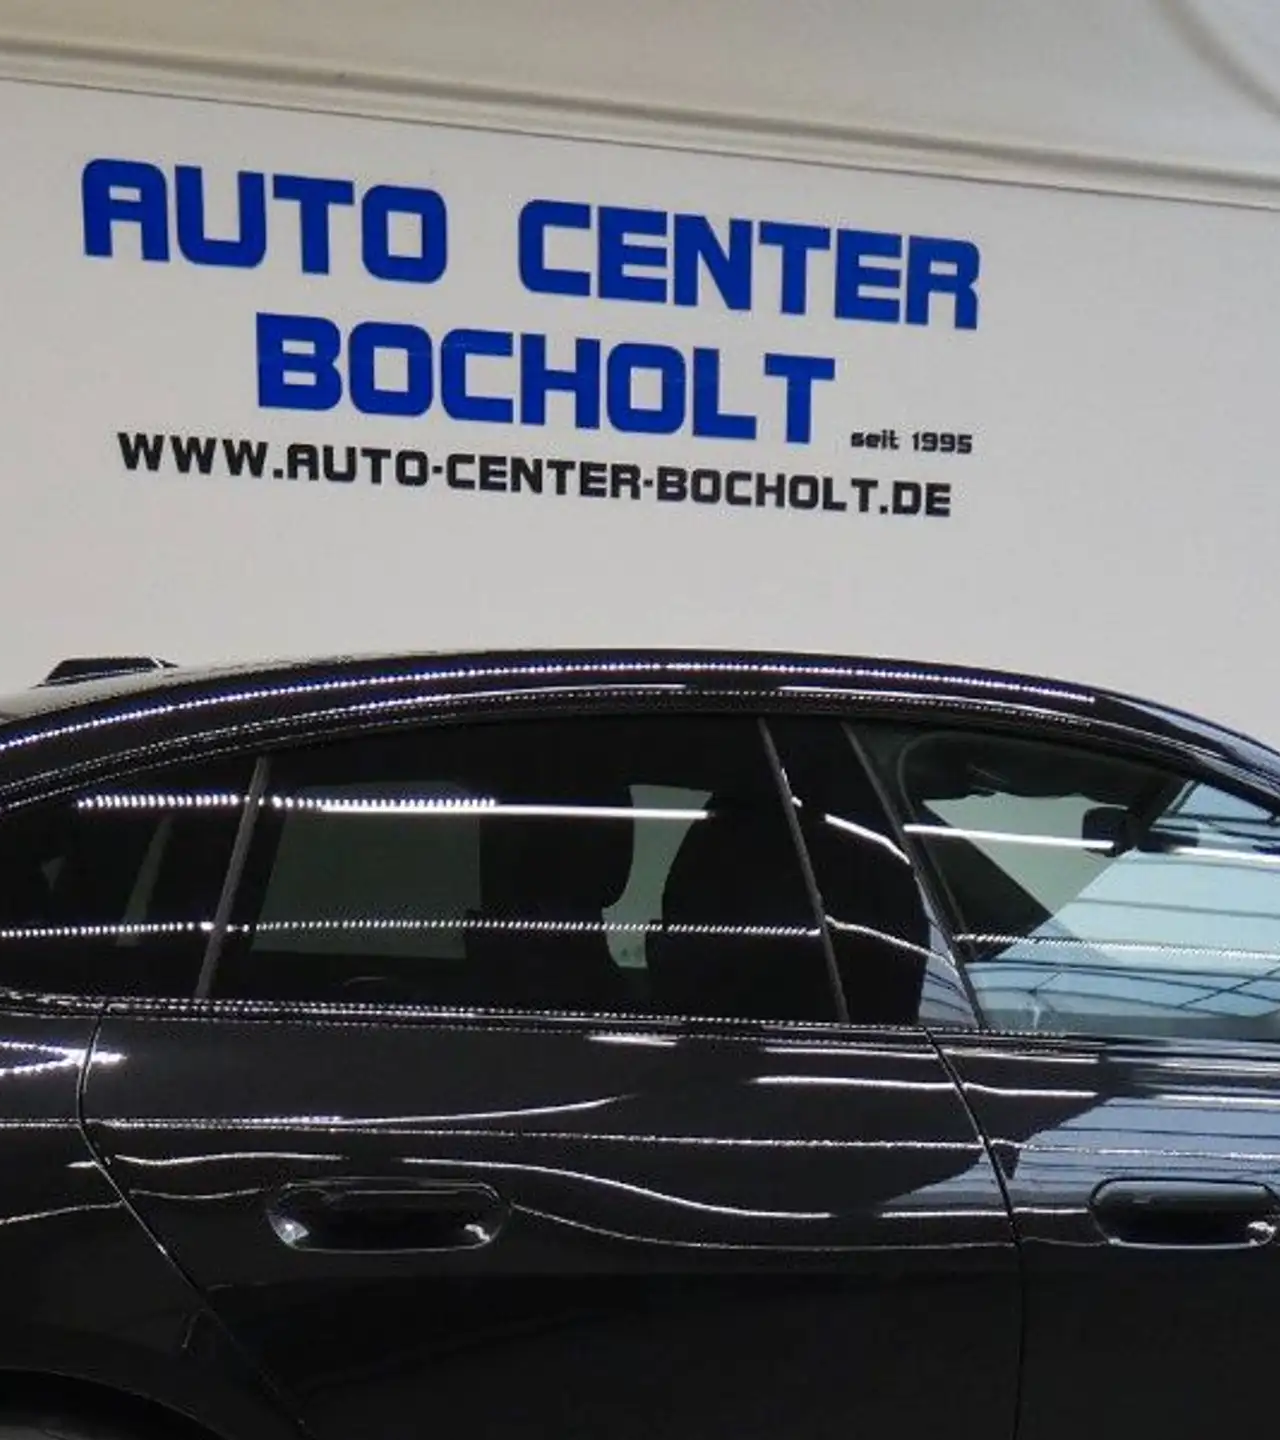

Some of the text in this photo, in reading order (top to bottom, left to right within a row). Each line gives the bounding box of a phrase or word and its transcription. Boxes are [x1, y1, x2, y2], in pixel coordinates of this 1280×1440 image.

[82, 158, 982, 330] AUTO CENTER
[255, 312, 837, 446] BOCHOLT
[117, 432, 952, 517] WWW.AUTO-CENTER-BOCHOLT.DE
[850, 429, 973, 454] seit 1995
